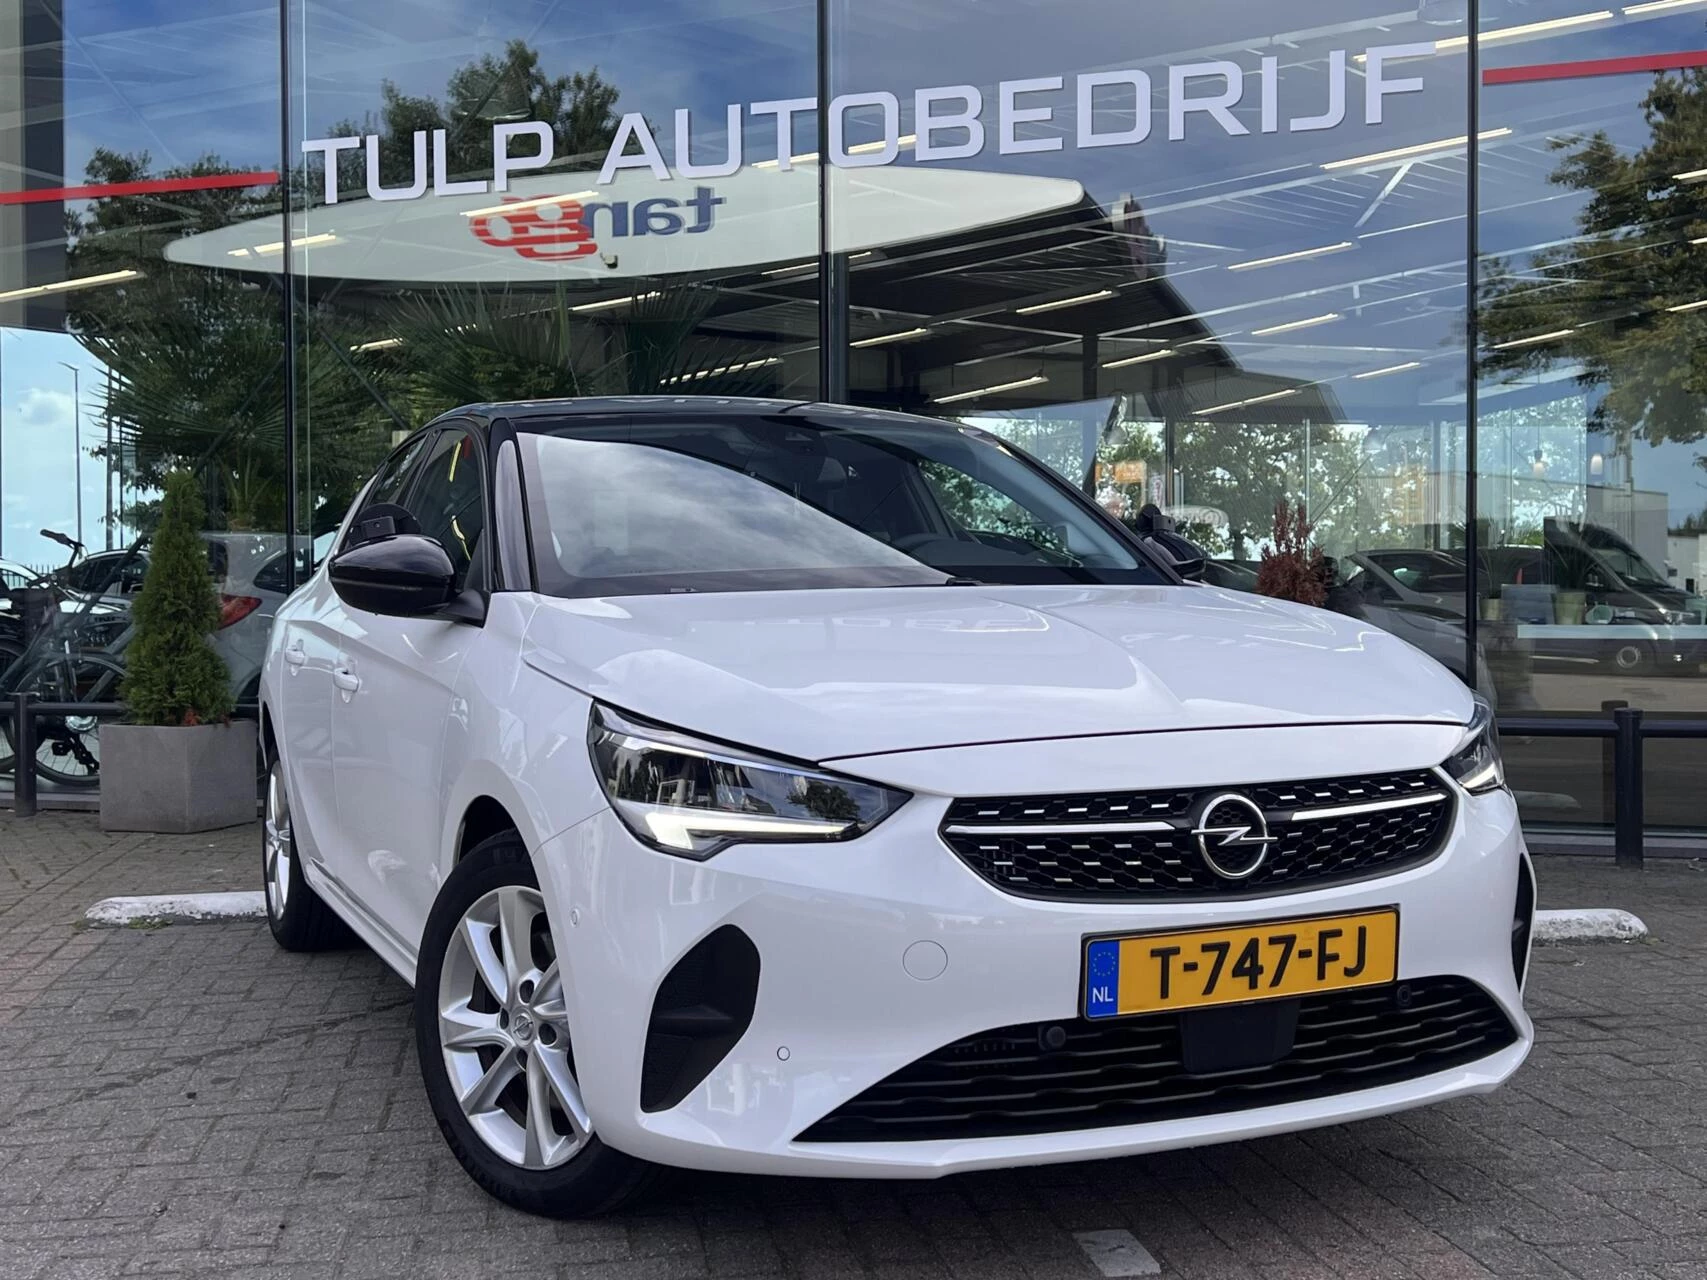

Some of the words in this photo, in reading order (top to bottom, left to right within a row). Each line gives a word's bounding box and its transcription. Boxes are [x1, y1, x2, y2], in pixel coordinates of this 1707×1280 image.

[302, 120, 554, 205] TULP
[596, 41, 1437, 185] AUTOBEDRIJF
[1092, 986, 1114, 1004] NL
[1150, 925, 1367, 1000] T-747-FJ
